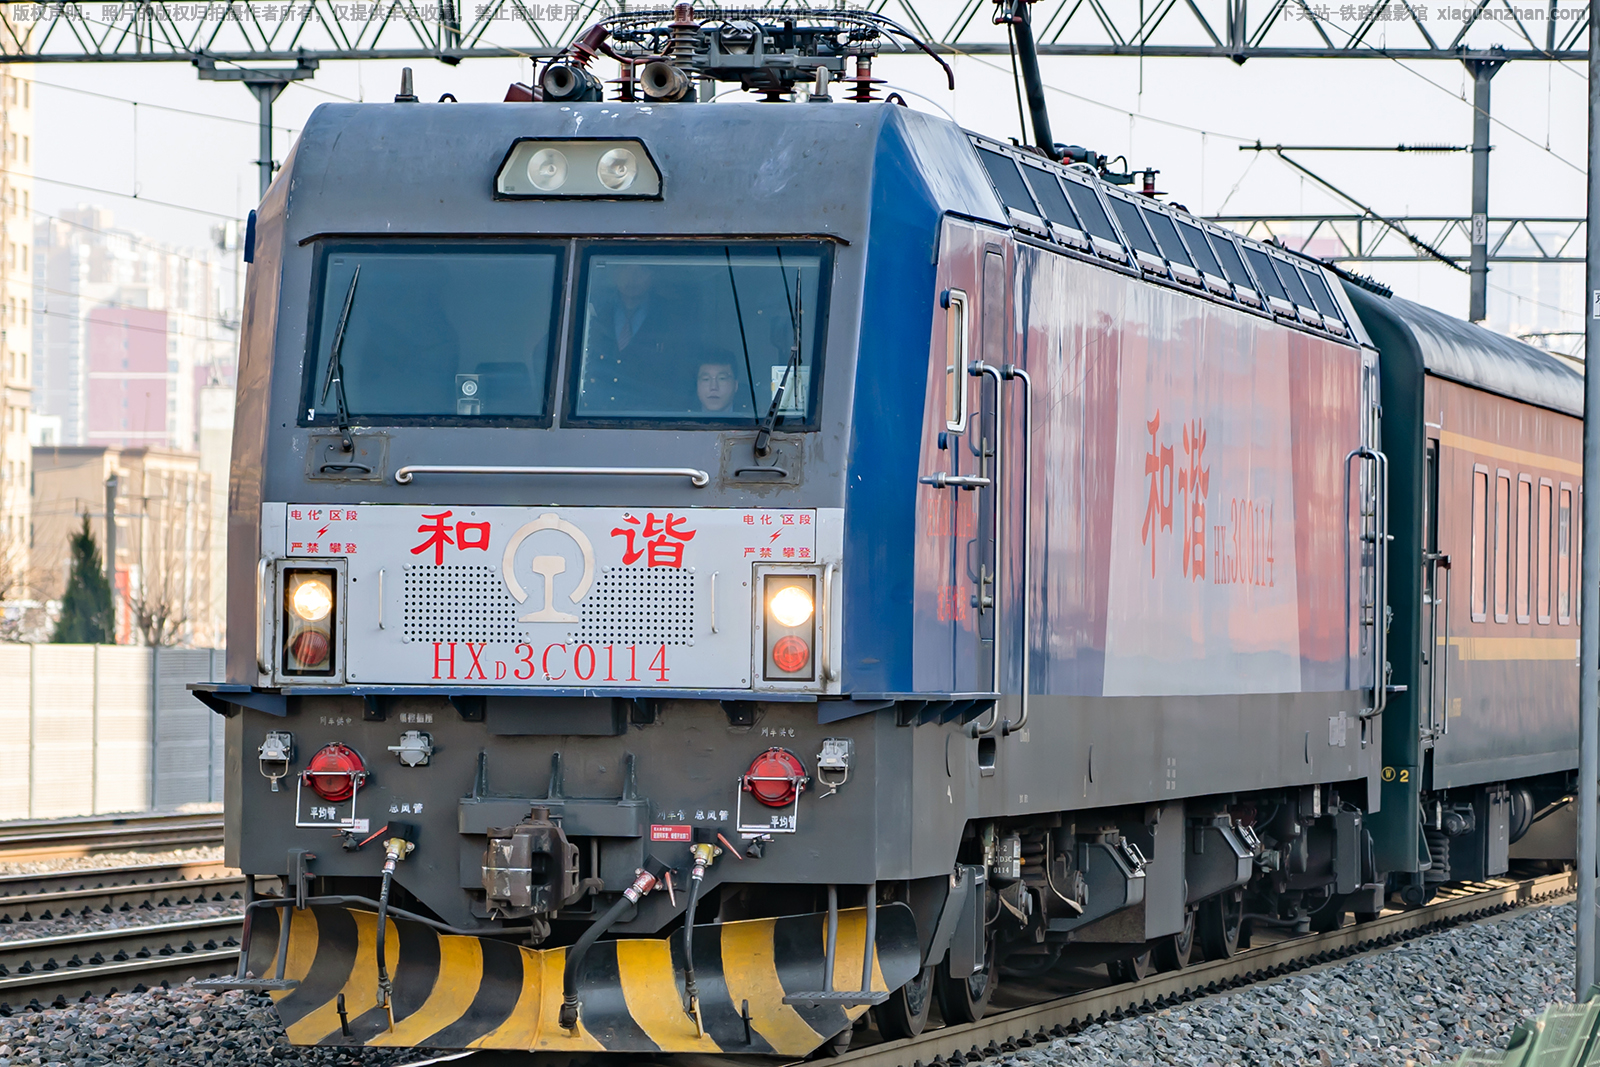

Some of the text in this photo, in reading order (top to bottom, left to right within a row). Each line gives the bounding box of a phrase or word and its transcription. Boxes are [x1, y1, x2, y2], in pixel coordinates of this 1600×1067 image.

[1142, 408, 1210, 583] 和谐
[410, 510, 697, 569] 和 谐
[431, 642, 671, 682] HXD3C0114
[1400, 769, 1409, 782] 2
[310, 806, 336, 820] 平均管
[389, 803, 424, 814] 总风管
[695, 809, 729, 821] 总风管
